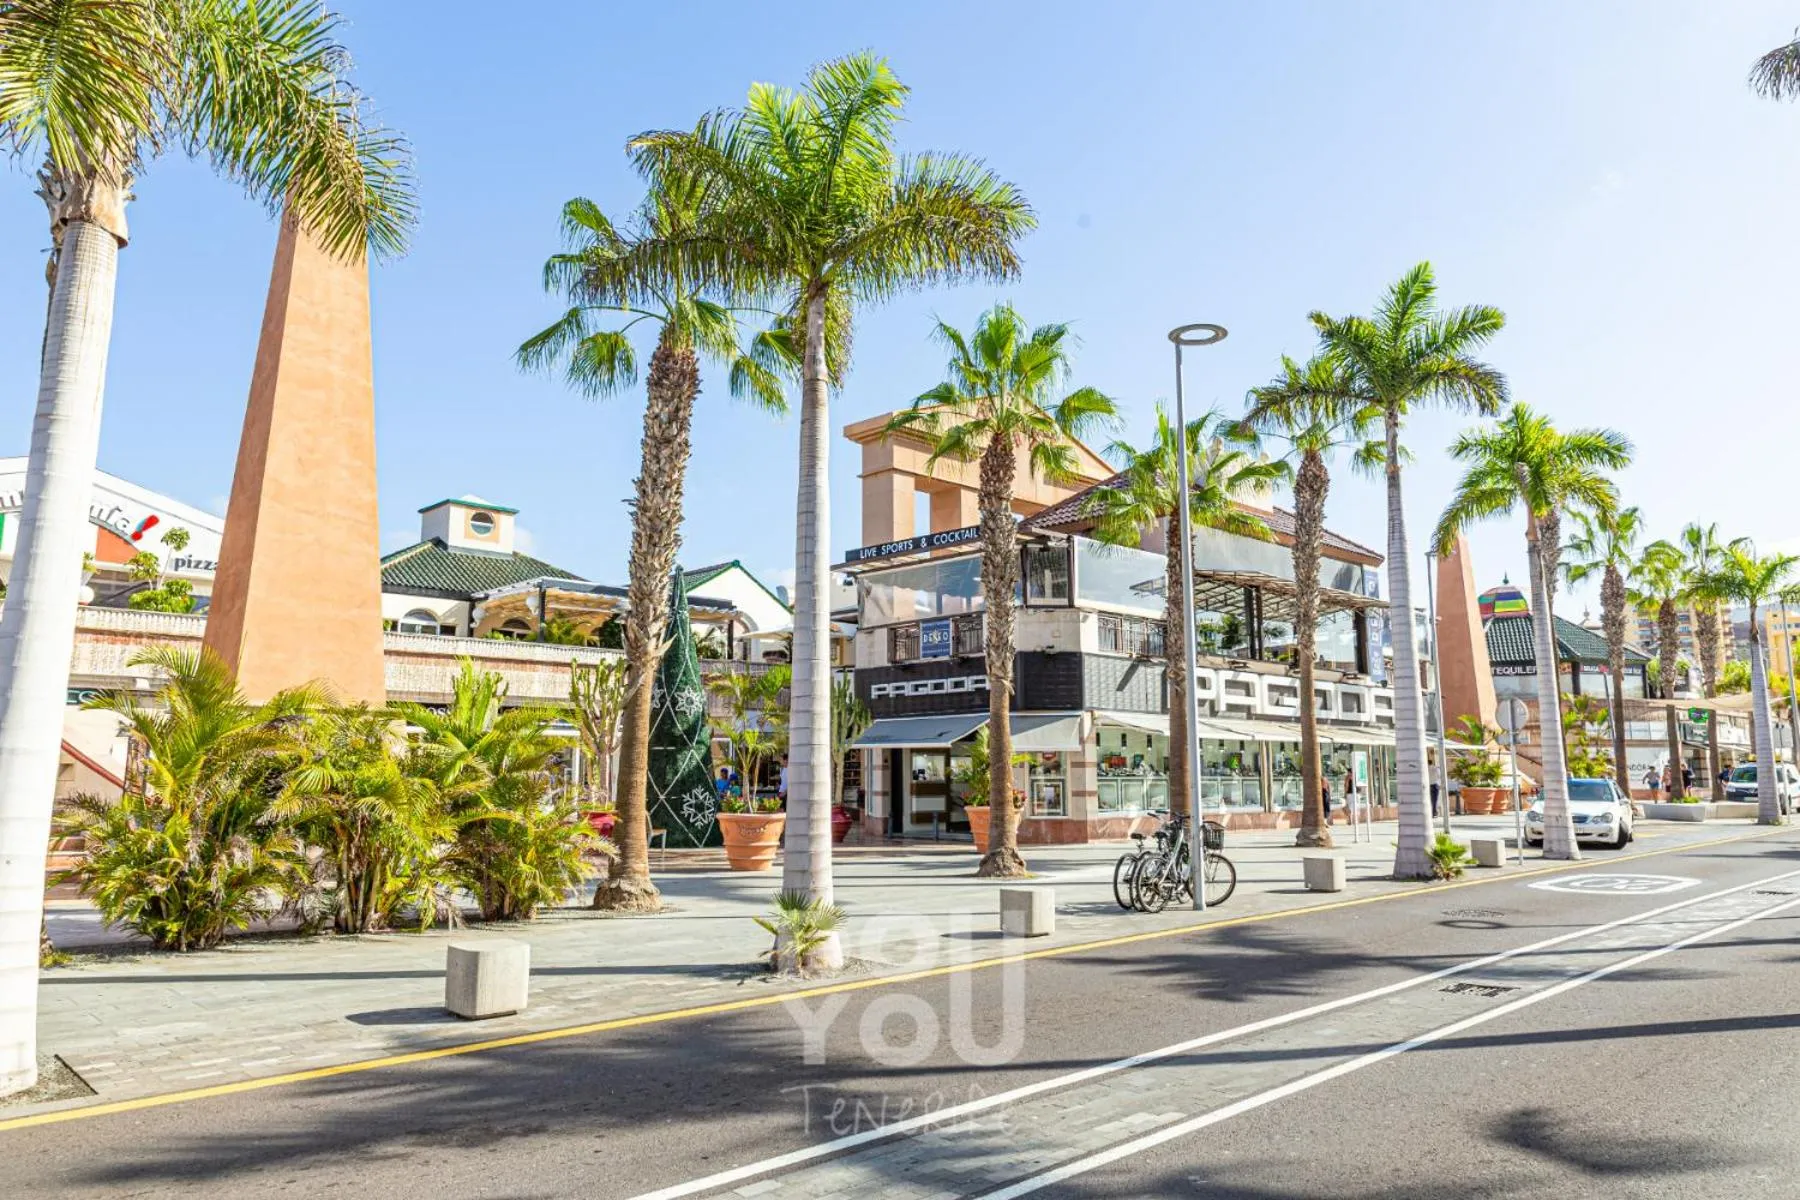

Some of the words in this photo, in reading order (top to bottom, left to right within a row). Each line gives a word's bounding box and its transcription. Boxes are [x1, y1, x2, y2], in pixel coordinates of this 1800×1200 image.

[860, 548, 877, 559] LIVE
[881, 540, 913, 554] SPORTS
[920, 537, 927, 549] &
